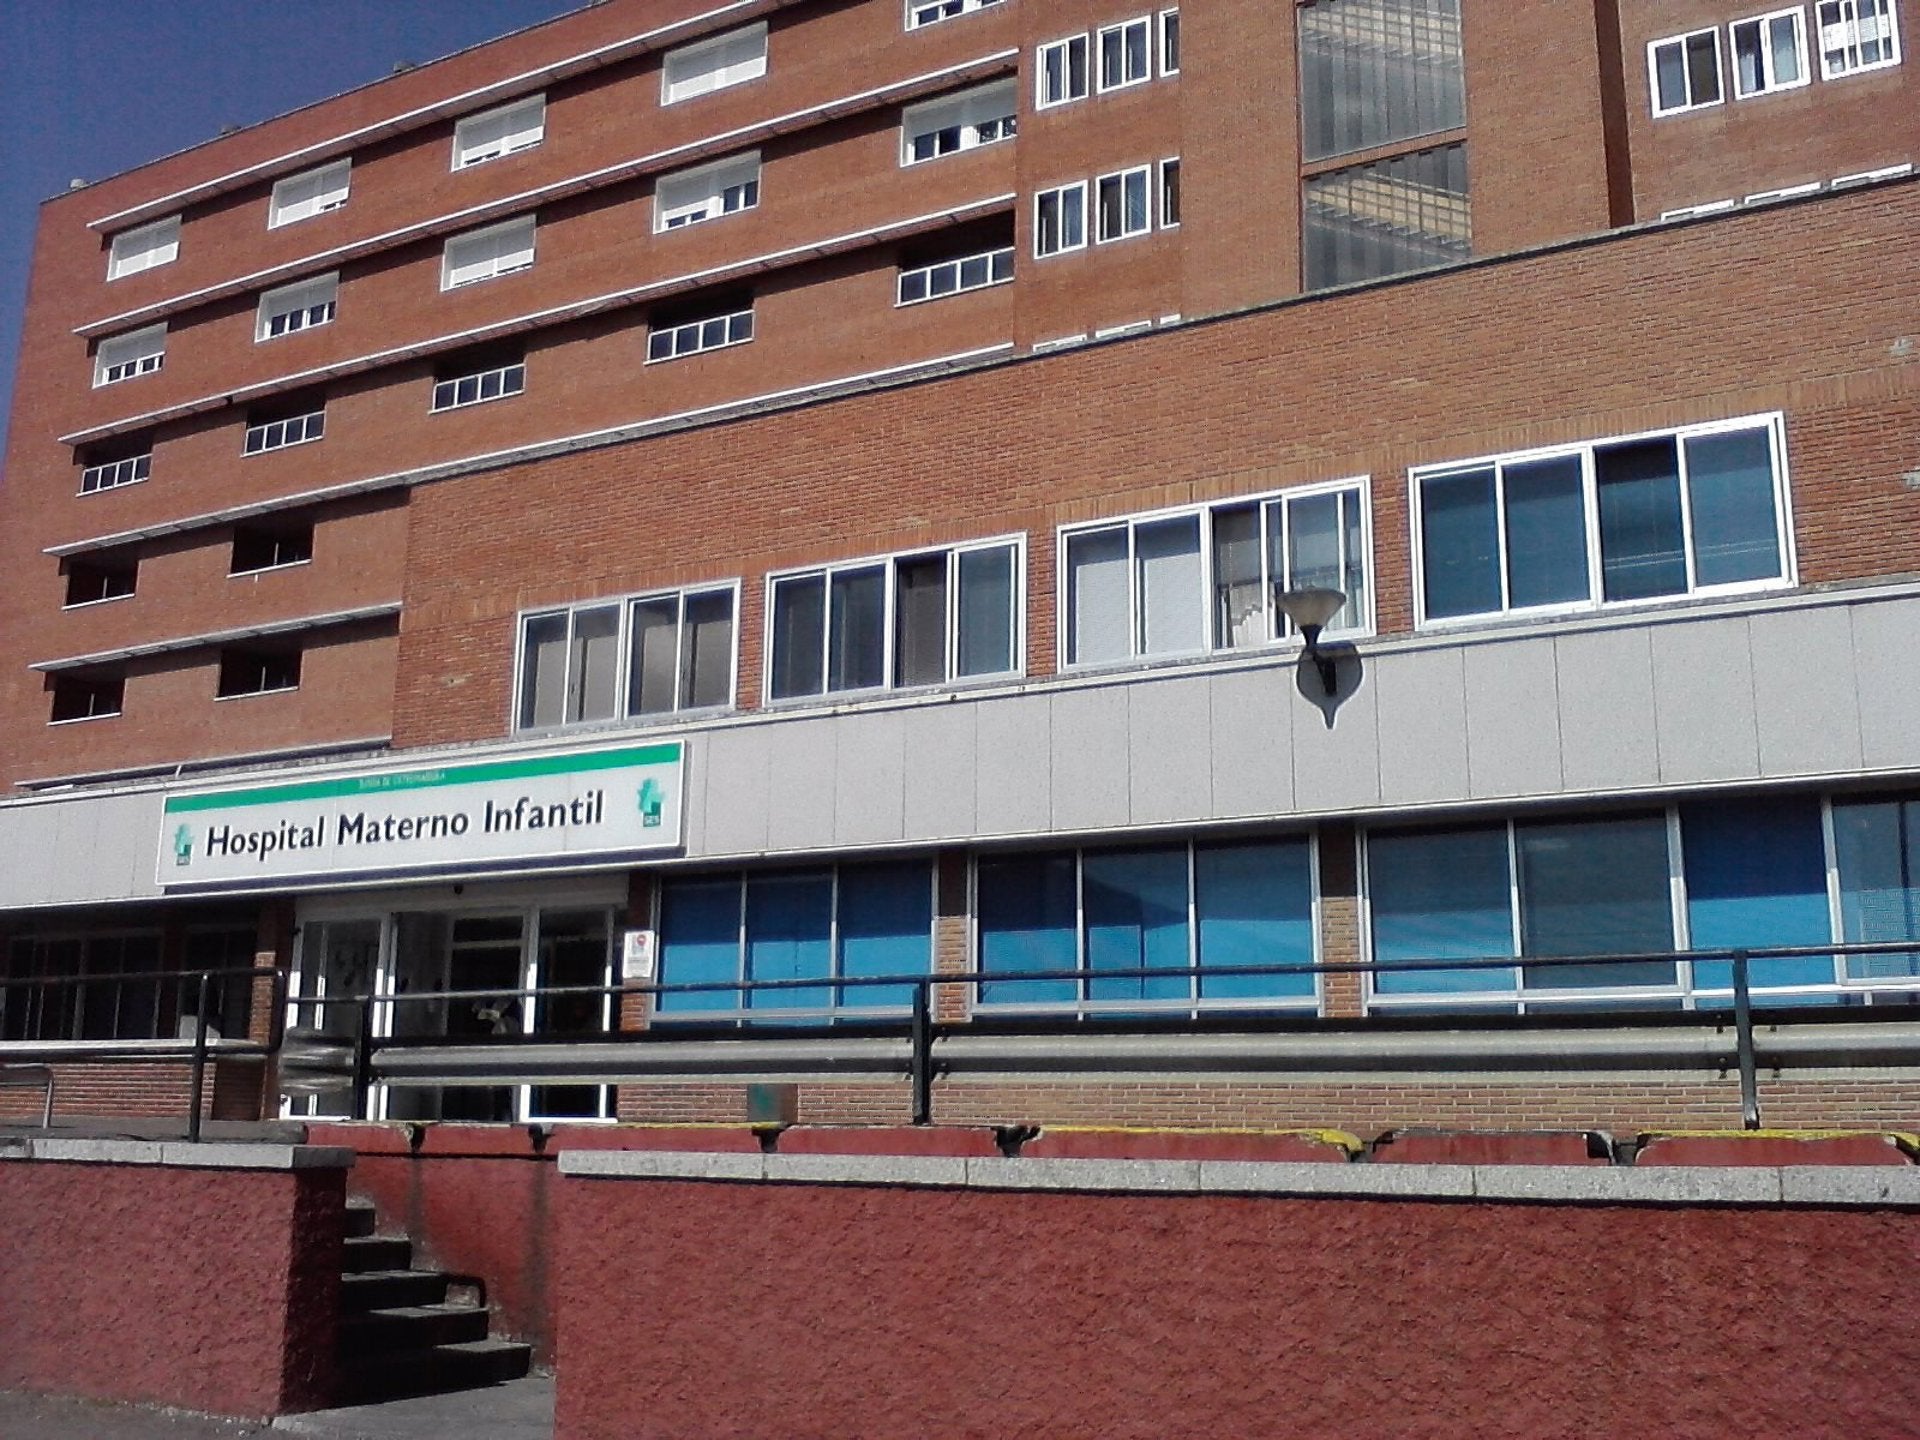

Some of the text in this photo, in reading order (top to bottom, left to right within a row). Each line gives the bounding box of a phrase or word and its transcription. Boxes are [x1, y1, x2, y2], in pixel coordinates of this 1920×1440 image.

[206, 789, 604, 862] Hospital Materno Infantil
